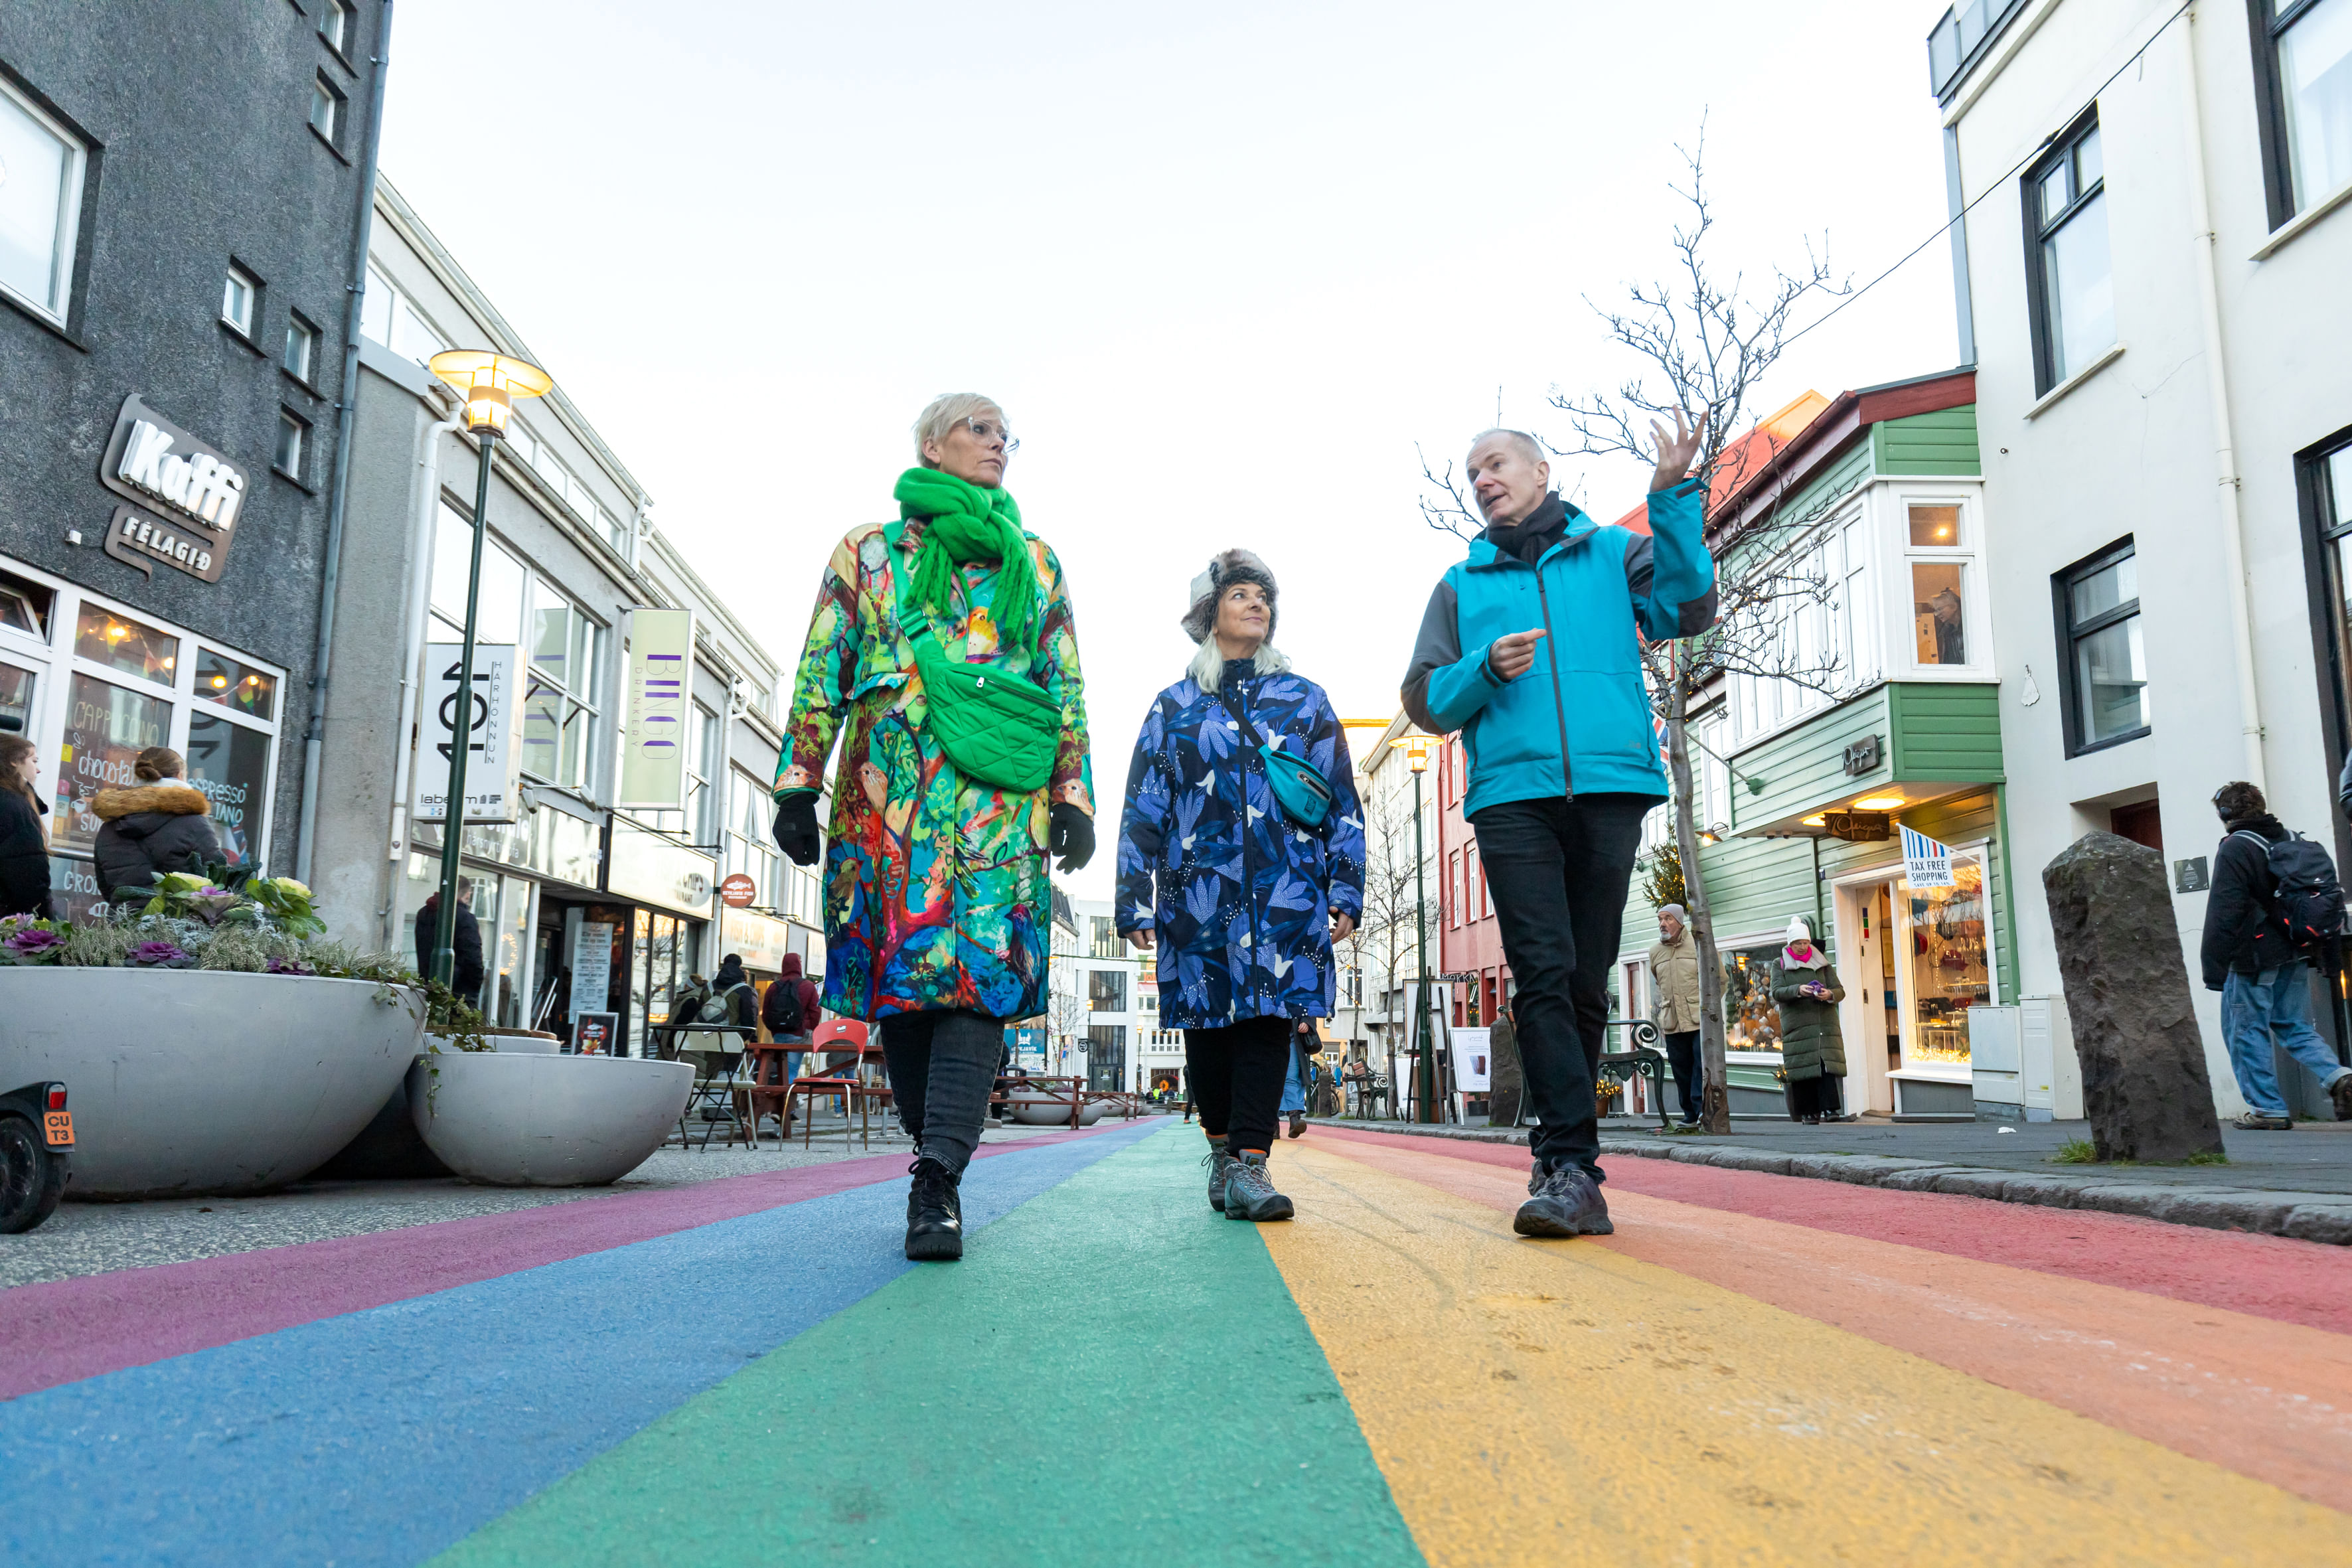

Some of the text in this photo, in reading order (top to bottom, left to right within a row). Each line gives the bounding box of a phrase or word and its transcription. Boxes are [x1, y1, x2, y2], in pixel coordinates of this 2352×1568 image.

[118, 419, 240, 532] Kaffi
[122, 516, 212, 572] FÉLAGIÐ
[74, 701, 159, 747] CAPPCCNO
[436, 661, 491, 764] 101
[486, 661, 503, 764] HÁRHÖNNUN
[631, 666, 643, 747] DRINKERY
[641, 654, 682, 760] BINGO
[78, 750, 137, 787] chocolat
[206, 802, 244, 824] IANO
[420, 793, 477, 805] labem
[1909, 860, 1946, 871] TAX FREE
[1912, 872, 1948, 882] SHOPPING
[1441, 973, 1476, 984] MOKKA
[48, 1116, 69, 1127] CU
[51, 1130, 69, 1141] T3
